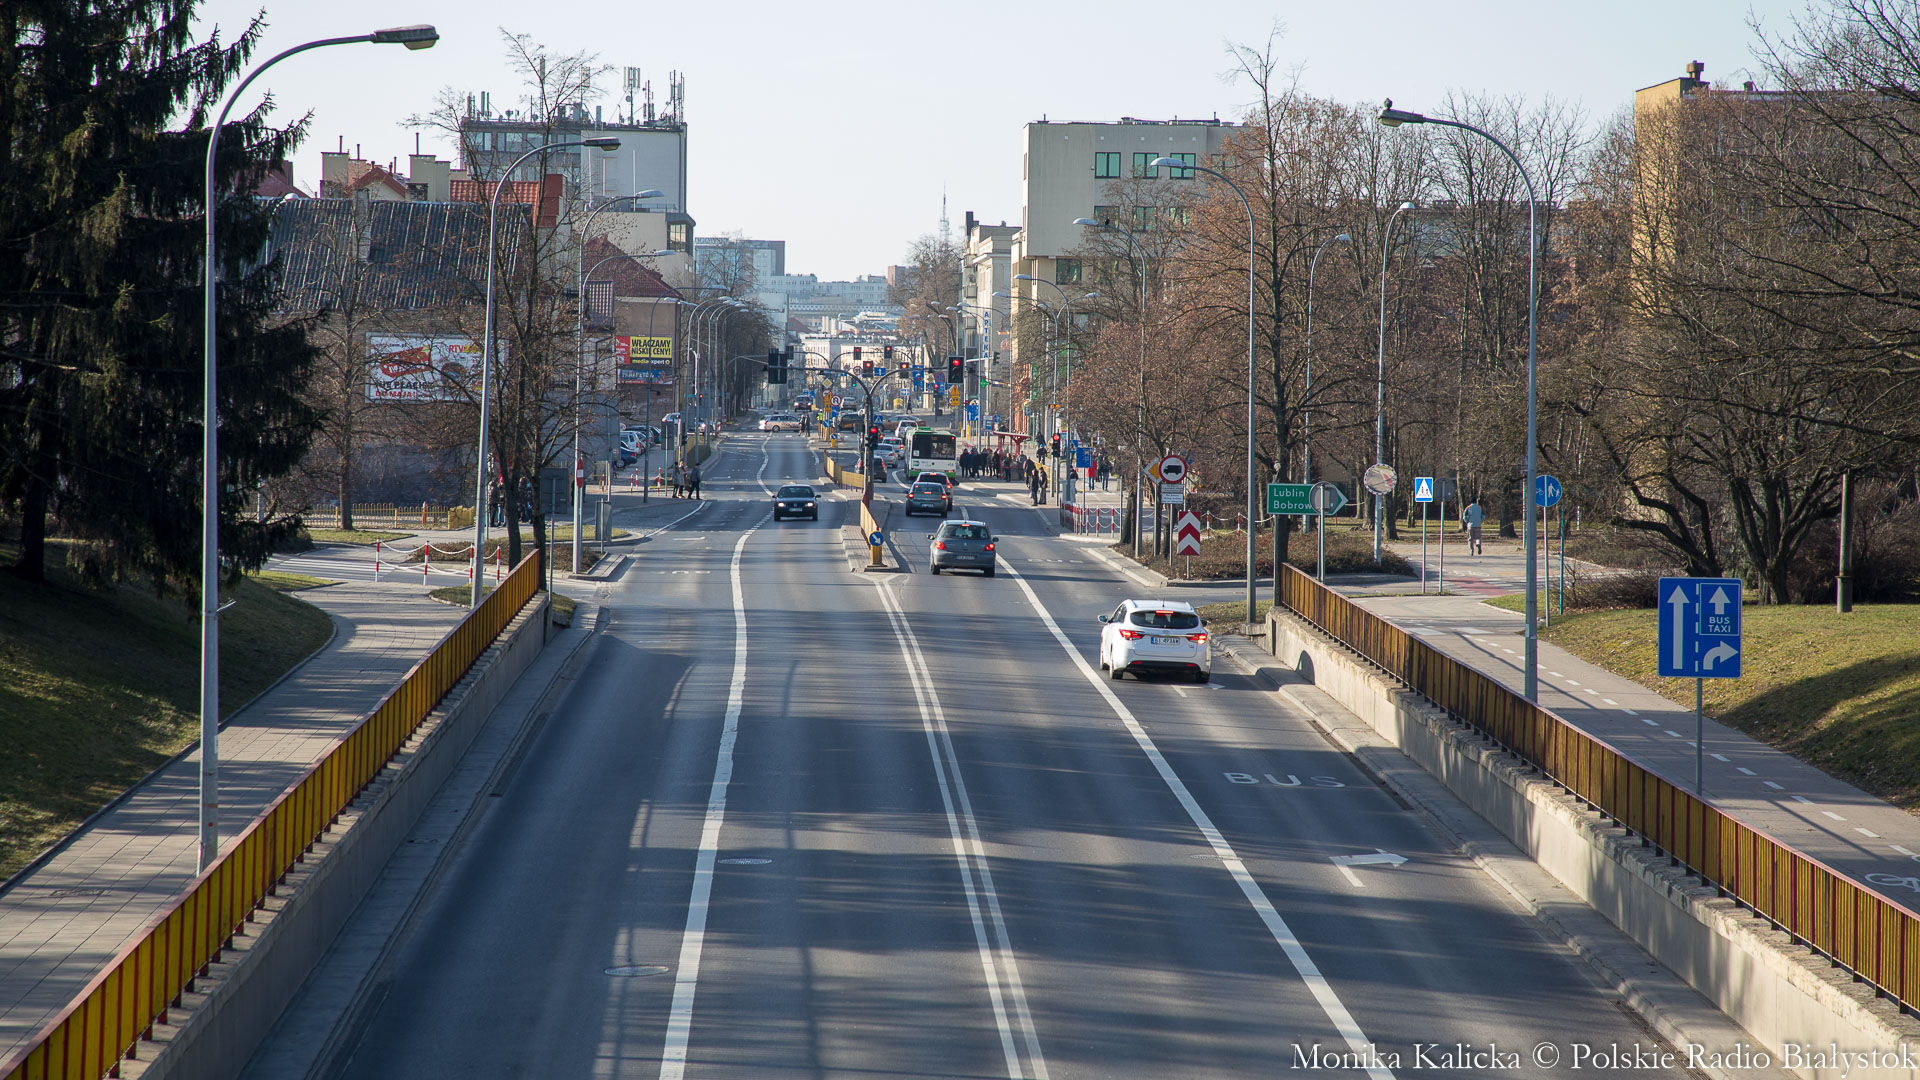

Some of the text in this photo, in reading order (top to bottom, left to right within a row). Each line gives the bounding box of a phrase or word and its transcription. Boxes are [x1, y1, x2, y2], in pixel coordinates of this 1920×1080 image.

[652, 347, 671, 356] CENY!
[1273, 488, 1305, 497] Lublin
[1709, 616, 1730, 624] BUS
[1708, 624, 1731, 632] TAXI
[1223, 772, 1346, 788] BUS
